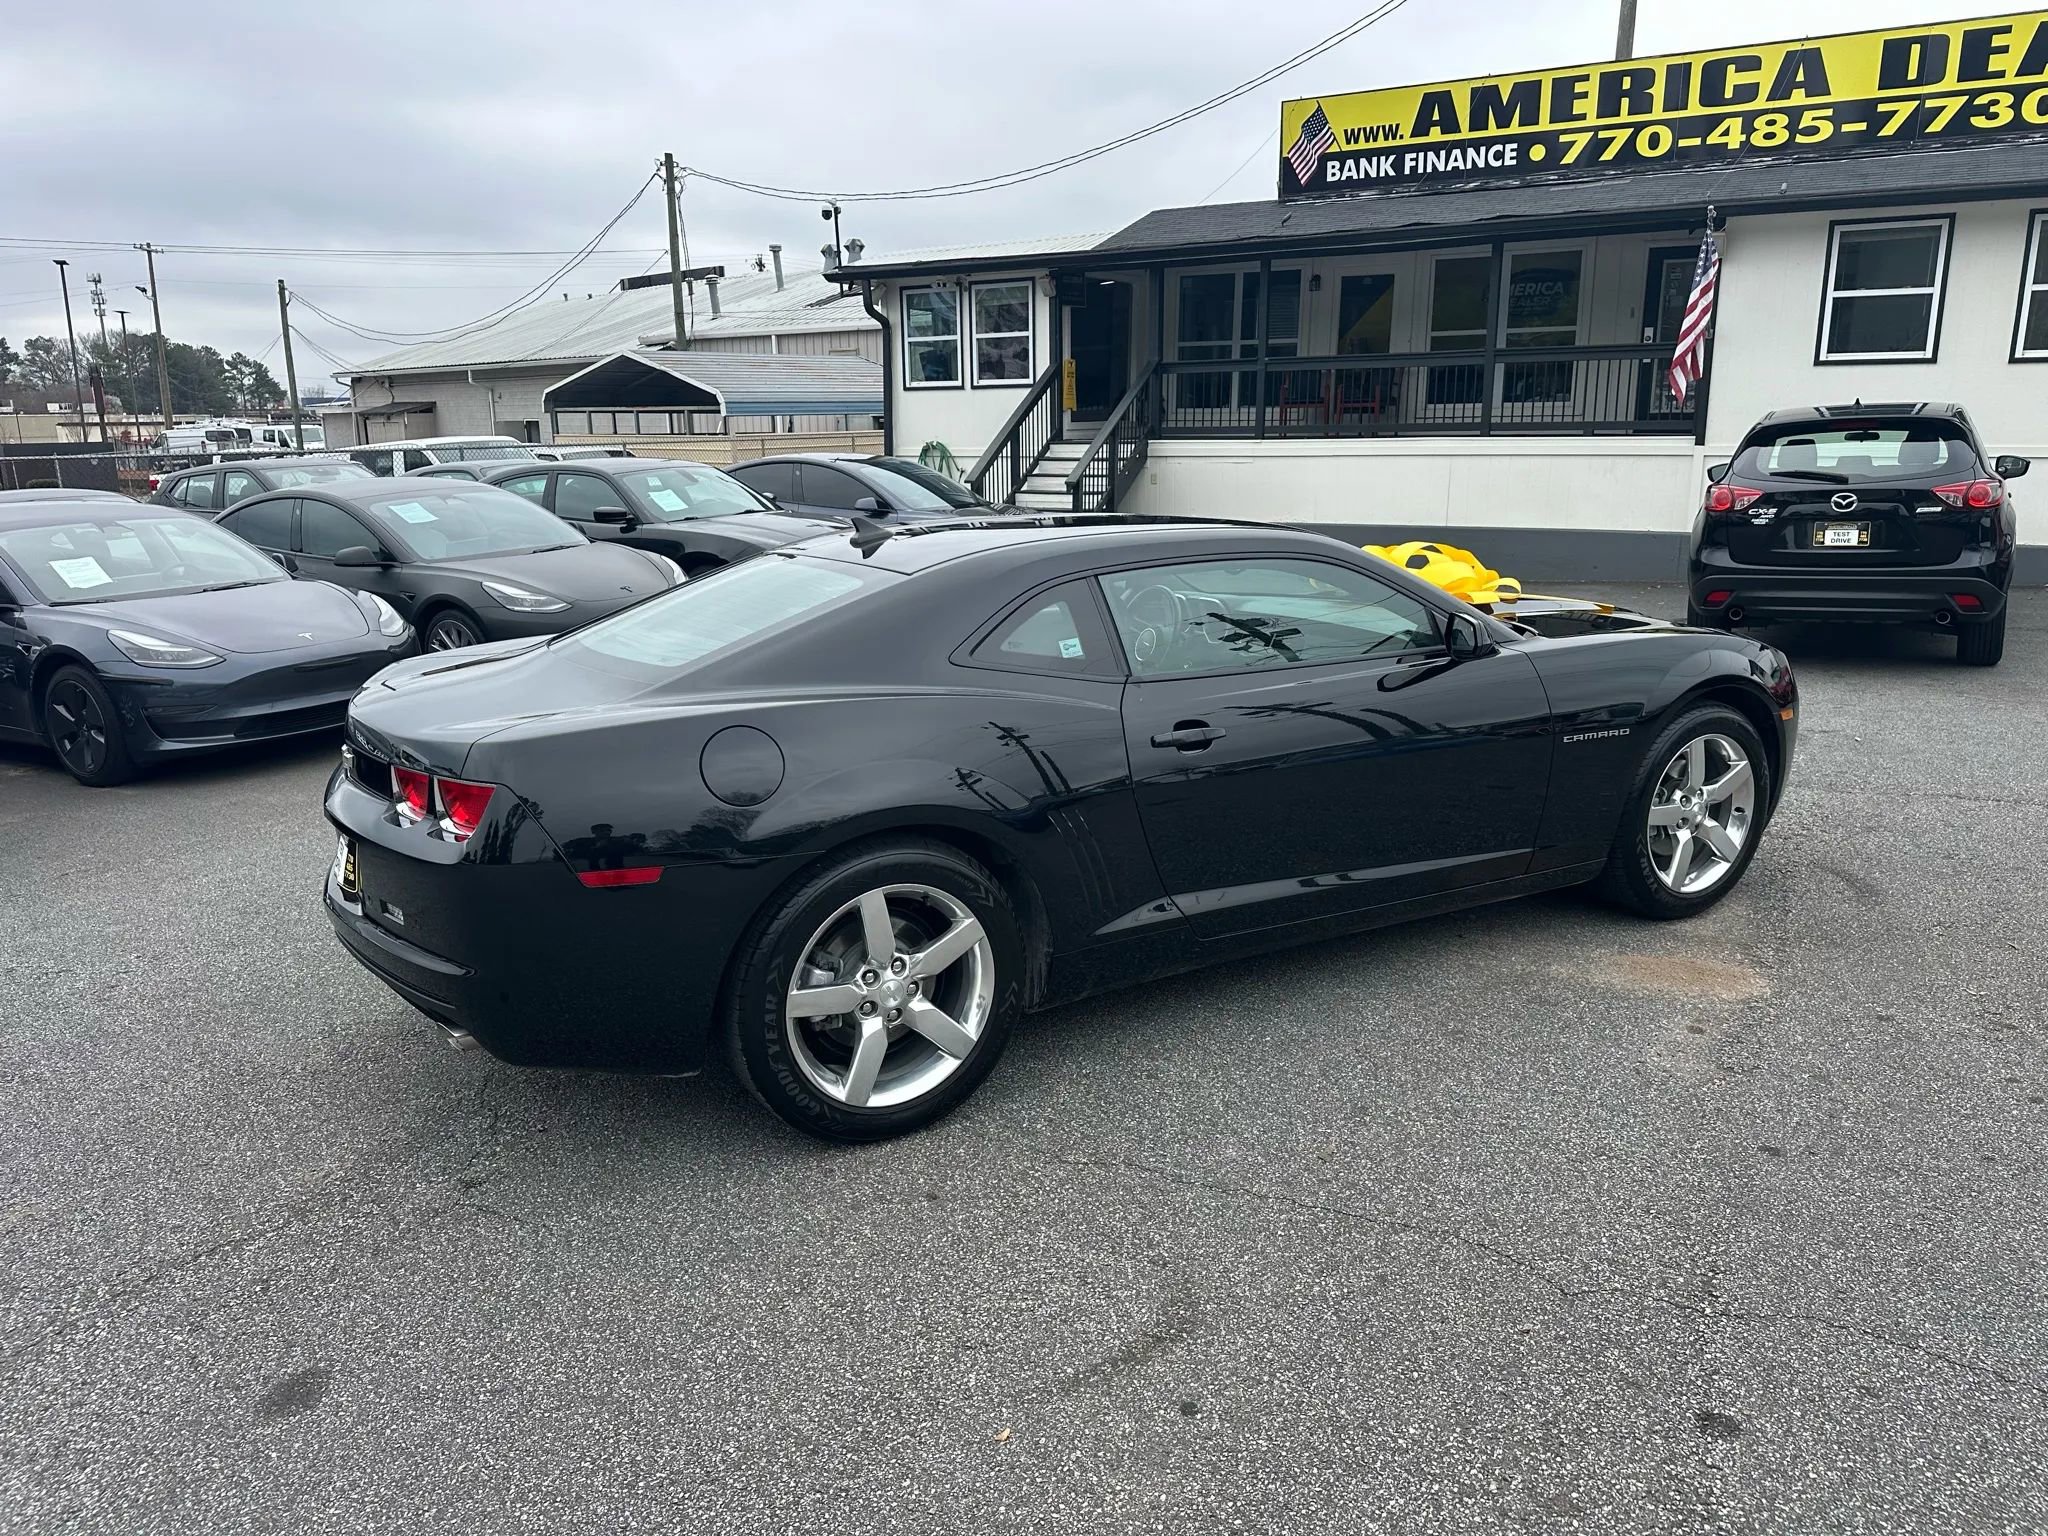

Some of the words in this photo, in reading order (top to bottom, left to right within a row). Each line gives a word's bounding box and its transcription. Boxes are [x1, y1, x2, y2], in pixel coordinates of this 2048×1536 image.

[1409, 46, 1832, 139] AMERICA
[1326, 154, 1397, 183] BANK
[1403, 142, 1518, 176] FINANCE
[1563, 728, 1630, 743] CAMARO
